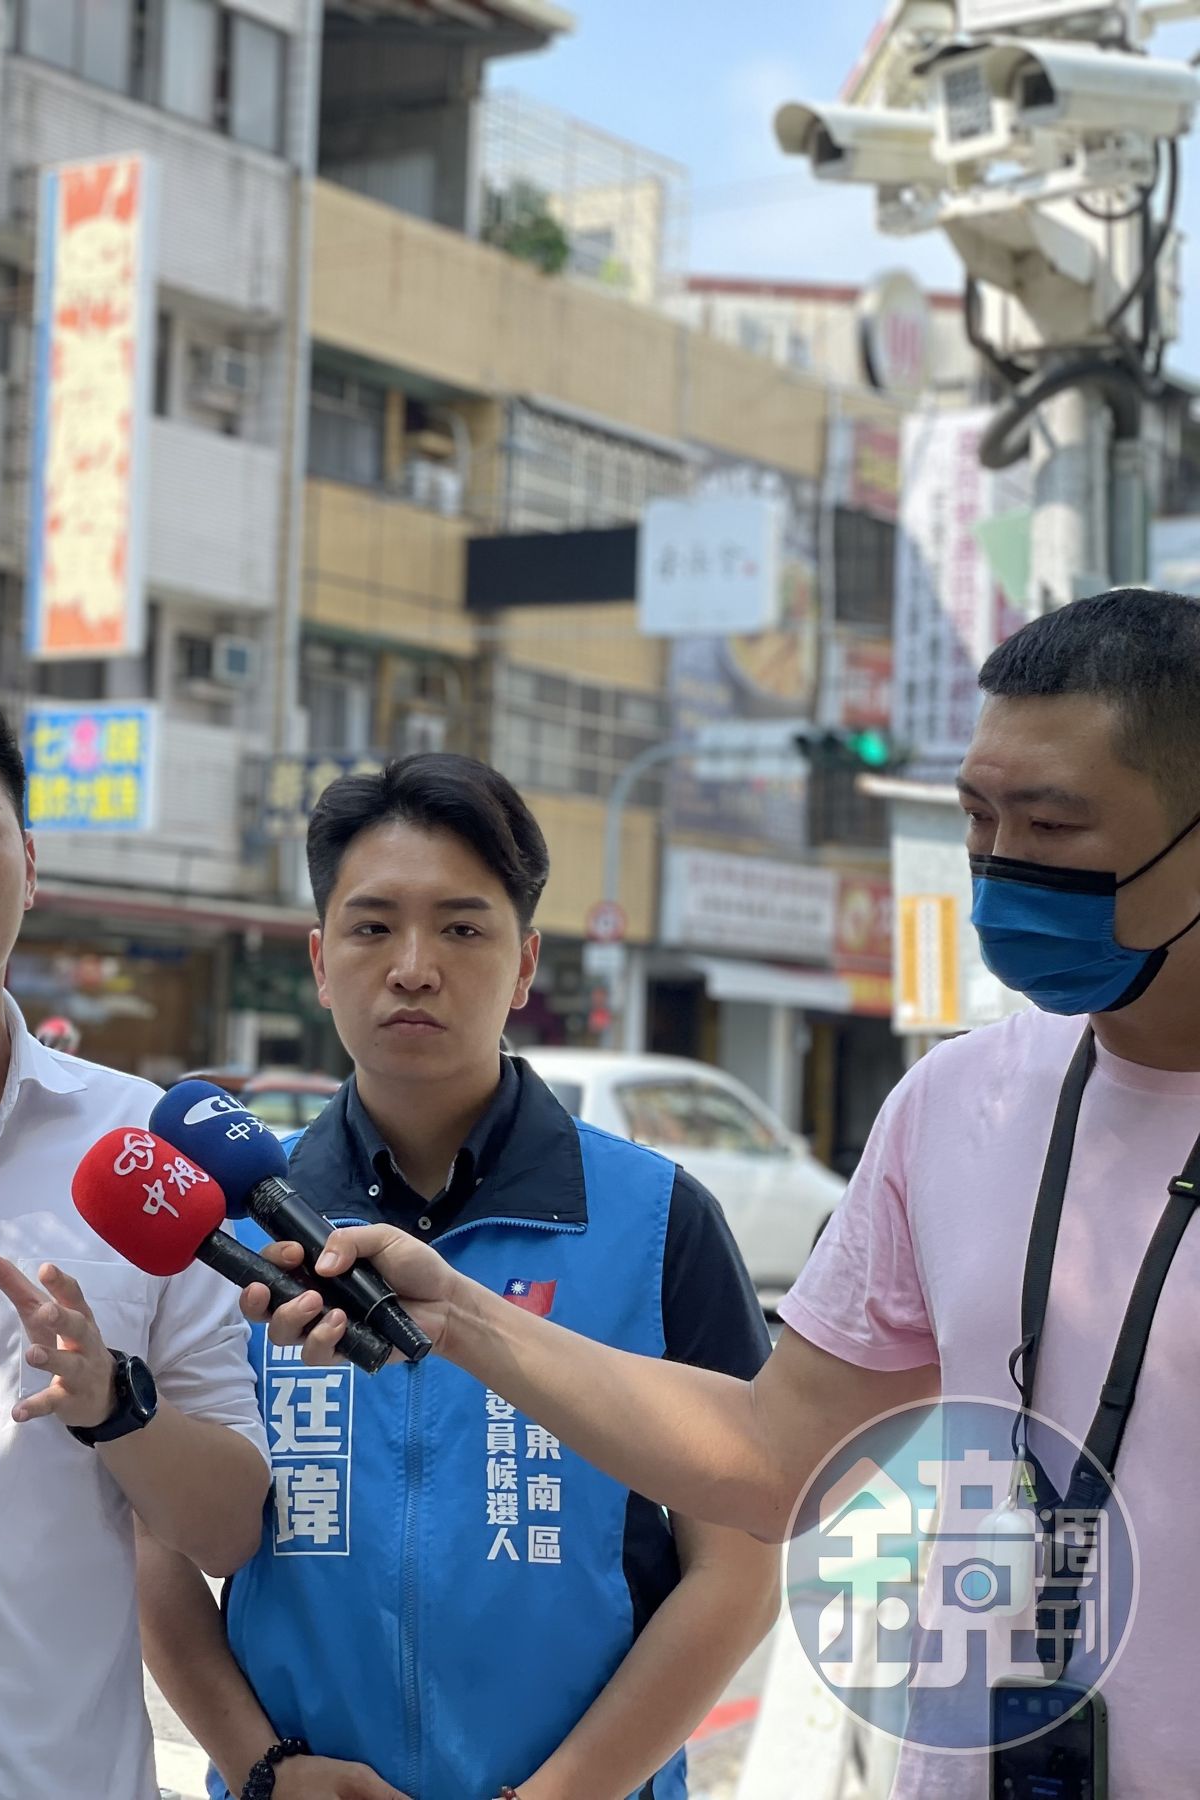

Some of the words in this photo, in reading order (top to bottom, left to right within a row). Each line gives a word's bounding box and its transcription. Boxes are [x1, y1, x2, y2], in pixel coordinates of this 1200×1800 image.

[142, 1157, 209, 1217] 中視
[271, 1345, 344, 1544] 廷瑋
[485, 1389, 520, 1561] 委員候選人
[524, 1425, 562, 1564] 東南區
